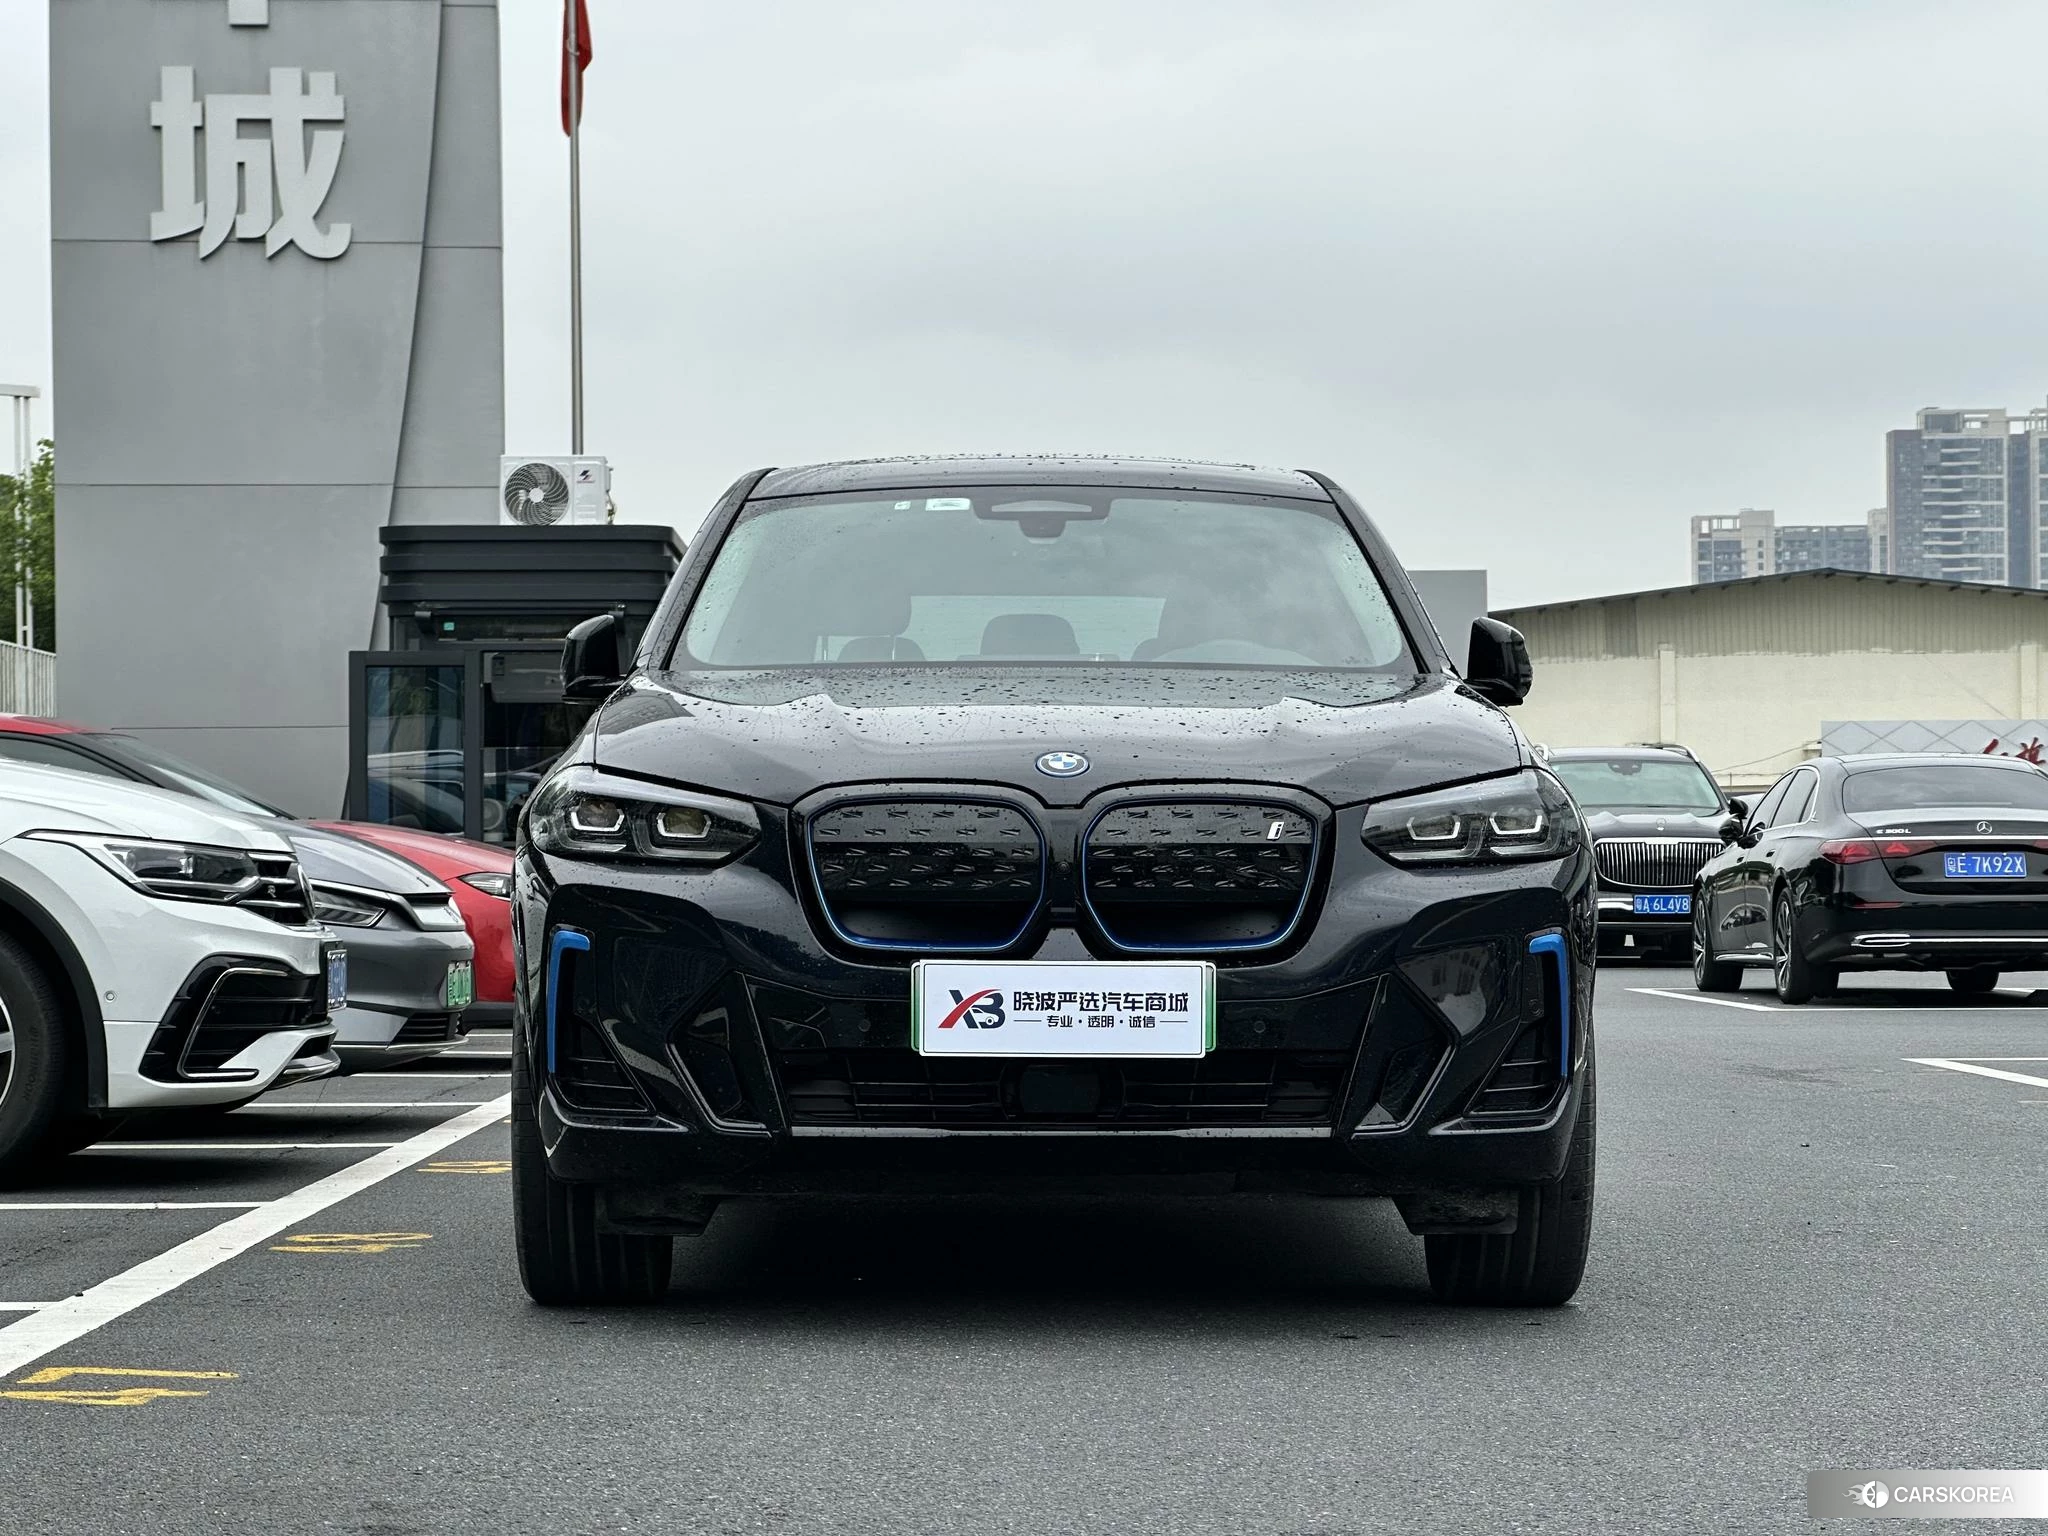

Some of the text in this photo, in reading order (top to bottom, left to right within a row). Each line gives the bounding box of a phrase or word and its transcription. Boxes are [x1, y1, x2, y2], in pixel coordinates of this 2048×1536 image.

[150, 0, 352, 260] 城
[1013, 991, 1189, 1012] 晓波严选汽车商城
